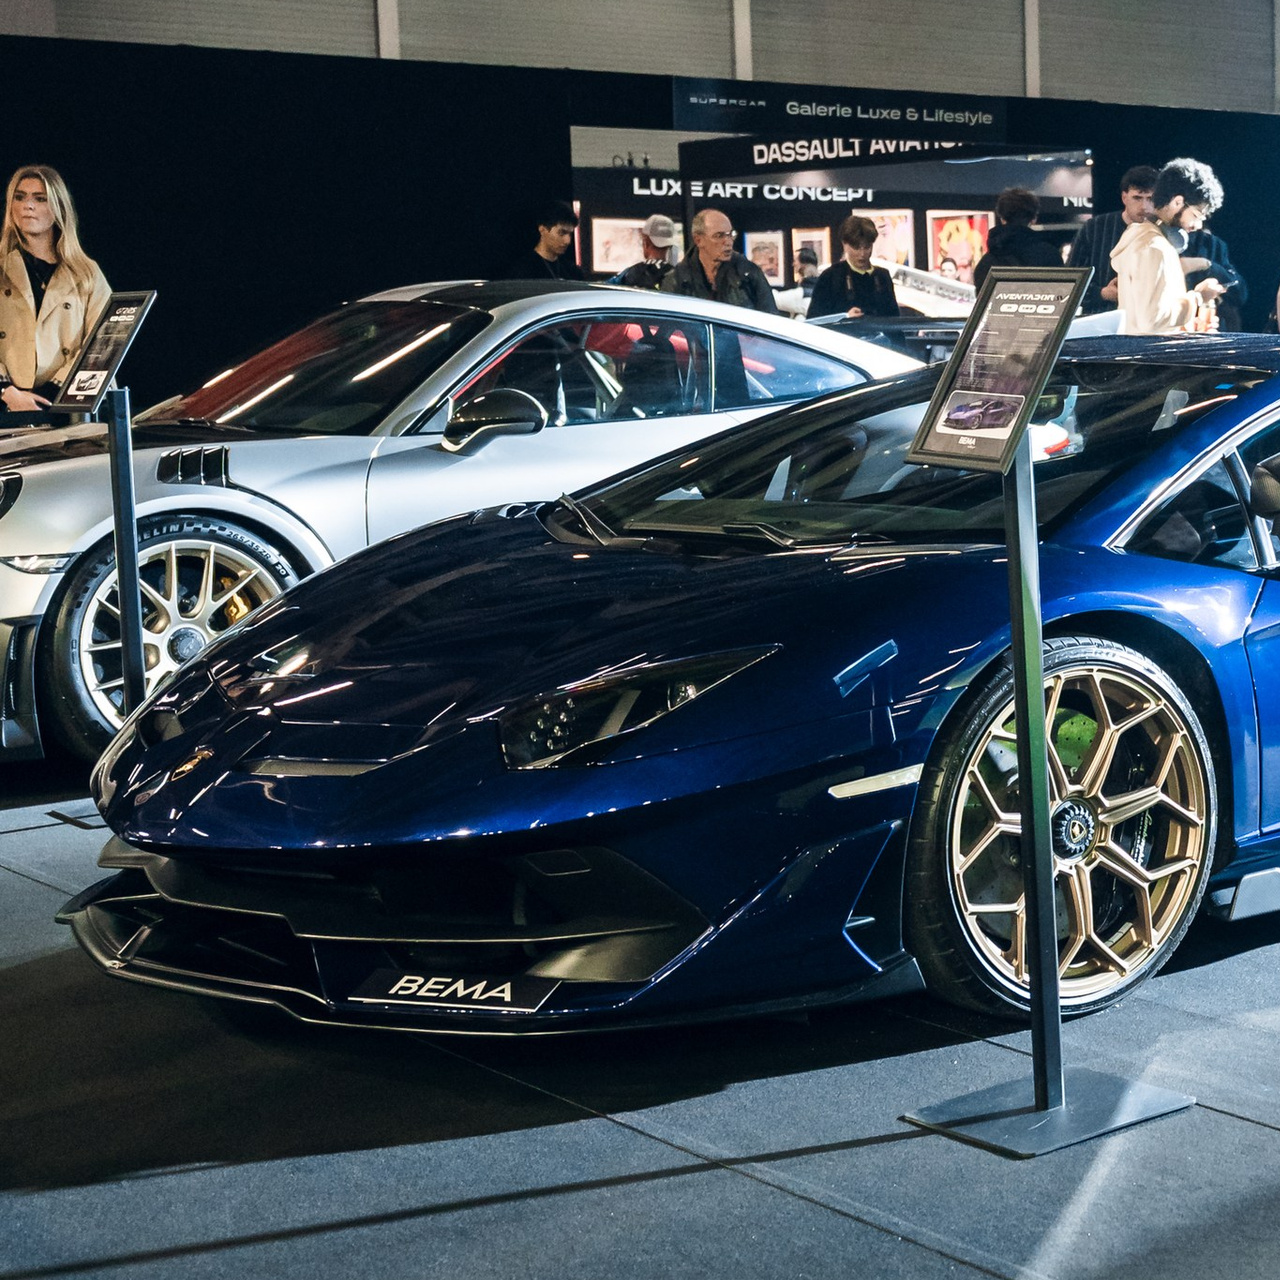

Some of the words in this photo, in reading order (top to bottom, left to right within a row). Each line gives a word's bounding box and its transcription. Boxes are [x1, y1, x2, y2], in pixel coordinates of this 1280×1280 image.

[689, 97, 766, 107] SUPERCAR
[786, 101, 852, 117] Galerie
[857, 105, 901, 120] Luxe
[906, 108, 919, 121] &
[923, 109, 993, 126] Lifestyle
[753, 138, 862, 164] DASSAULT
[633, 177, 704, 197] LUXE
[707, 182, 758, 199] ART
[763, 184, 874, 202] CONCEPT
[995, 293, 1055, 301] AVENTADOR
[226, 531, 272, 560] 265/35ZR
[275, 564, 287, 576] 20
[388, 975, 511, 1002] BEMA
